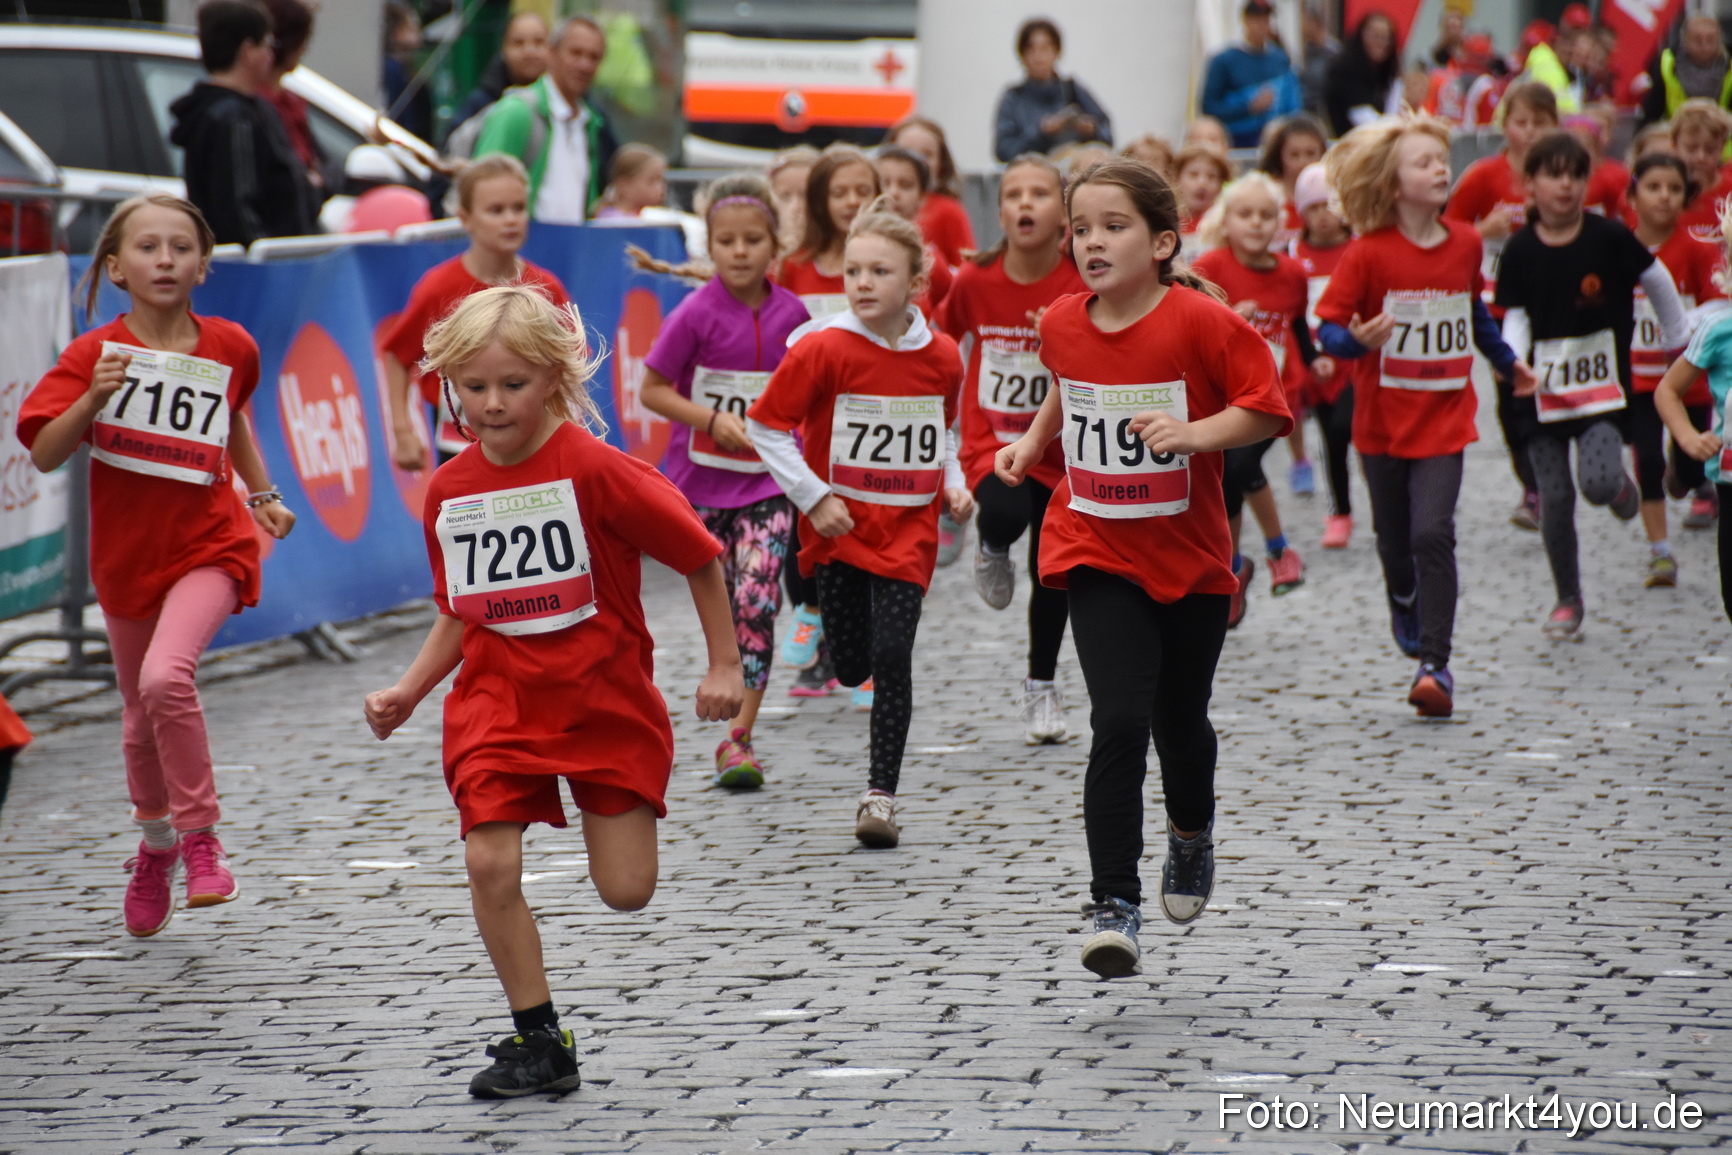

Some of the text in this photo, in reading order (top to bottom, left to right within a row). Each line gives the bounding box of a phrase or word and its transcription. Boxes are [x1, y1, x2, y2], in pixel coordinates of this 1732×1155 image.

[1395, 318, 1467, 354] 7108
[165, 355, 224, 382] BOCK
[1542, 353, 1609, 389] 7188
[990, 370, 1048, 407] 720
[1102, 387, 1173, 406] BOCK
[114, 376, 223, 435] 7167
[844, 406, 883, 415] NeuerMarkt
[889, 401, 937, 415] BOCK
[109, 431, 207, 466] Annemarie
[847, 422, 937, 463] 7219
[1071, 413, 1176, 467] 719
[863, 472, 915, 492] Sophia
[1091, 478, 1150, 500] Loreen
[492, 487, 564, 515] BOCK
[445, 511, 487, 524] NeuerMarkt
[453, 519, 575, 585] 7220
[579, 562, 587, 573] K
[453, 585, 460, 594] 3
[485, 594, 561, 620] Johanna
